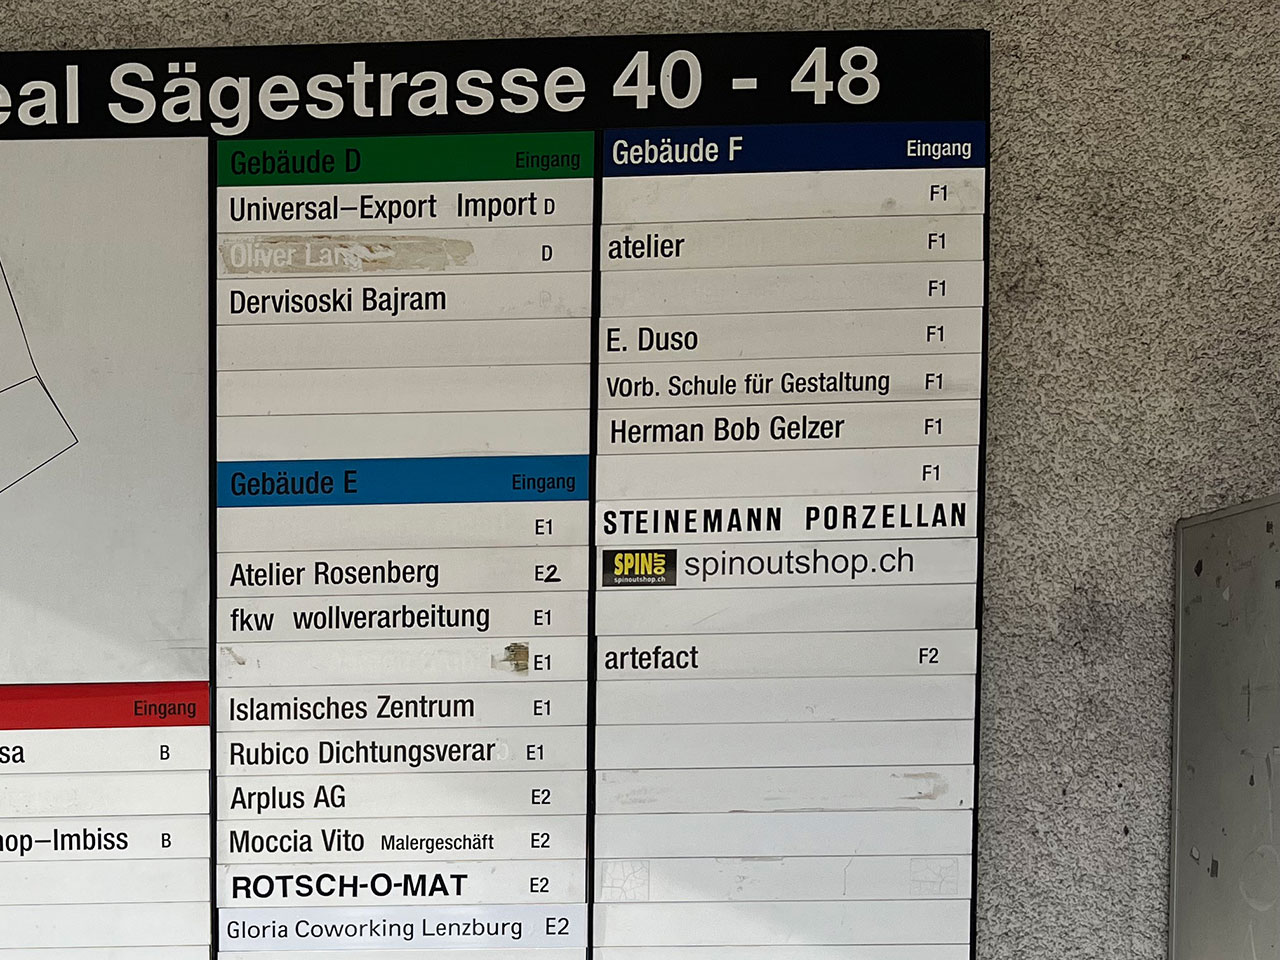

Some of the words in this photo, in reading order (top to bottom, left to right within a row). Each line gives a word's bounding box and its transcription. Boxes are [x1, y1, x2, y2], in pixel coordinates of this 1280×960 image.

[108, 61, 585, 135] Sägestrasse
[613, 50, 701, 109] 40
[733, 78, 757, 89] -
[791, 46, 880, 104] 48
[231, 150, 334, 175] Gebäude
[346, 149, 360, 173] D
[516, 152, 581, 171] Eingang
[613, 138, 718, 164] Gebäude
[729, 137, 742, 160] F
[908, 140, 971, 159] Eingang
[931, 185, 947, 201] F1
[458, 192, 537, 222] Import
[545, 199, 554, 214] D
[542, 245, 552, 261] D
[609, 234, 684, 259] atelier
[929, 233, 945, 249] F1
[929, 280, 945, 296] F1
[231, 288, 351, 314] Dervisoski
[363, 287, 445, 316] Bajram
[607, 328, 627, 351] E.
[639, 328, 697, 351] Duso
[927, 326, 943, 342] F1
[669, 375, 736, 396] Schule
[744, 374, 773, 394] für
[781, 372, 889, 395] Gestaltung
[926, 374, 942, 389] F1
[612, 420, 703, 443] Herman
[715, 417, 759, 441] Bob
[771, 415, 844, 440] Gelzer
[925, 419, 941, 434] F1
[232, 471, 333, 495] Gebäude
[345, 470, 357, 493] E
[513, 474, 575, 493] Eingang
[923, 465, 939, 481] F1
[536, 519, 552, 534] E1
[604, 508, 781, 534] STEINEMANN
[806, 503, 965, 530] PORZELLAN
[230, 563, 305, 586] Atelier
[315, 560, 438, 588] Rosenberg
[535, 565, 561, 582] E2
[614, 553, 652, 575] SPIN
[685, 547, 913, 582] spinoutshop.ch
[614, 576, 665, 584] spinoutshop.ch
[230, 609, 274, 631] fkw
[293, 604, 489, 632] wollverarbeitung
[535, 610, 550, 625] E1
[534, 655, 550, 670] E1
[605, 646, 698, 669] artefact
[920, 648, 938, 663] F2
[135, 701, 196, 719] Eingang
[230, 697, 367, 721] Islamisches
[377, 696, 473, 718] Zentrum
[534, 700, 550, 715] E1
[161, 745, 169, 760] B
[231, 742, 308, 765] Rubico
[527, 745, 543, 760] E1
[231, 786, 304, 814] Arplus
[314, 785, 345, 808] AG
[532, 789, 550, 804] E2
[162, 833, 171, 848] B
[230, 830, 312, 853] Moccia
[321, 829, 364, 851] Vito
[382, 834, 494, 853] Malergeschäft
[532, 833, 550, 848] E2
[233, 873, 467, 898] ROTSCH-O-MAT
[531, 878, 549, 892] E2
[228, 921, 287, 938] Gloria
[296, 919, 413, 940] Coworking
[423, 919, 521, 939] Lenzburg
[546, 918, 568, 935] E2
